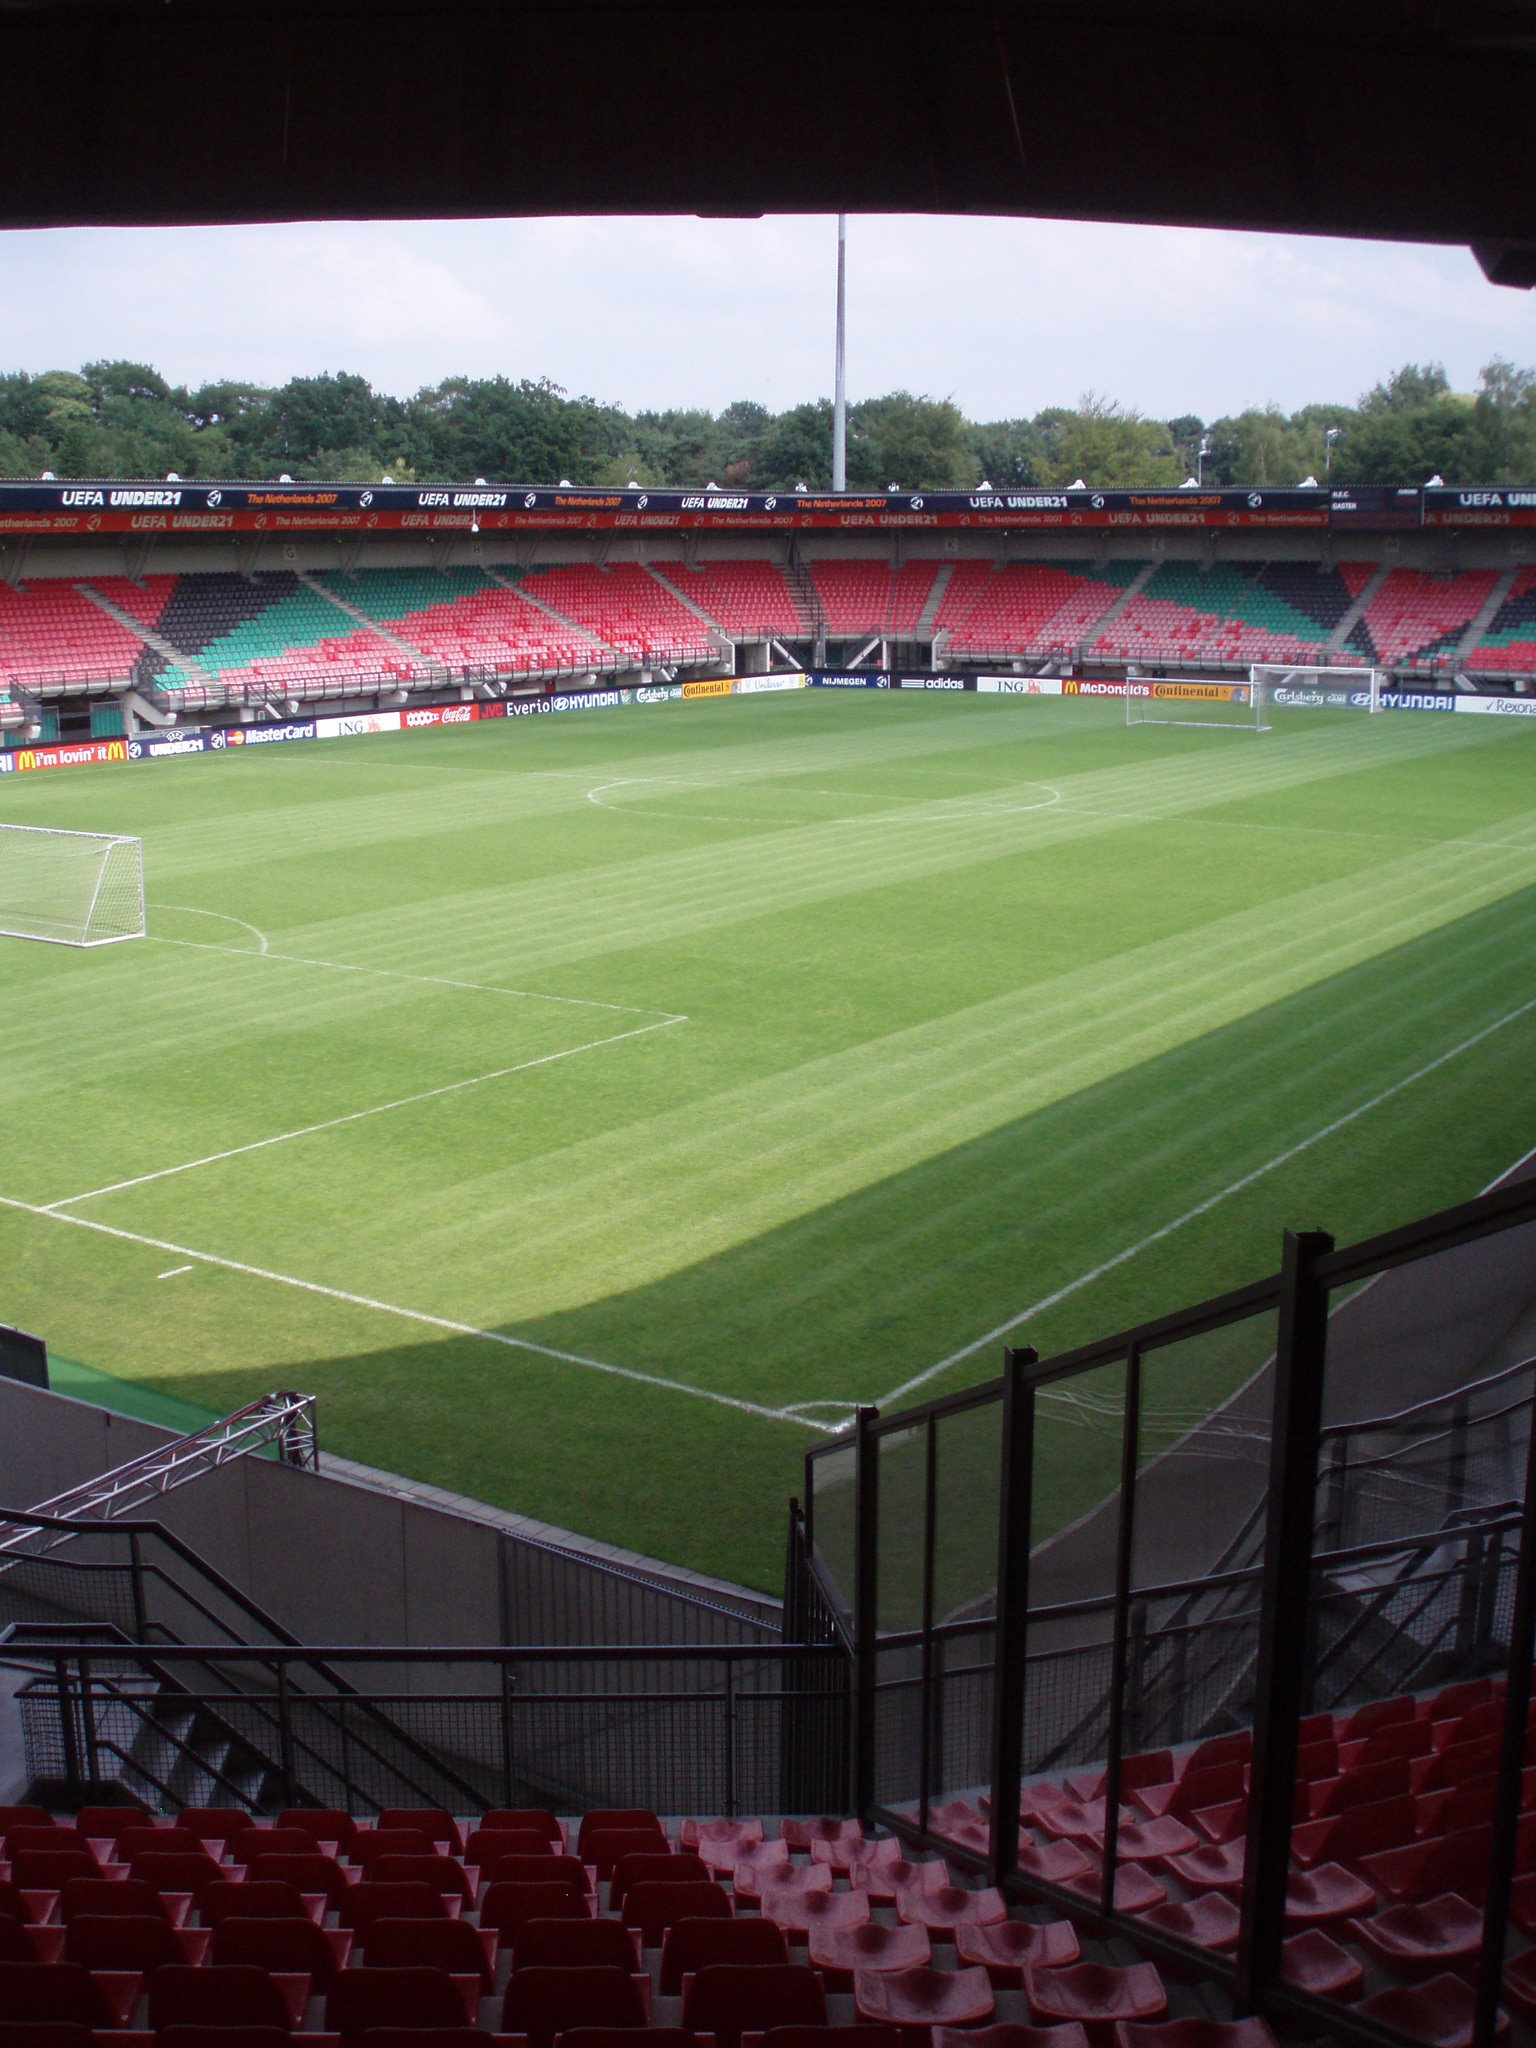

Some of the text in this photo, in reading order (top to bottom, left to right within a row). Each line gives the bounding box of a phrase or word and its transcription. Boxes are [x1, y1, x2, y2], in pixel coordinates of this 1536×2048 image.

[62, 491, 182, 505] UEFA UNDER21
[248, 494, 338, 504] The Netherlands 2007
[418, 493, 507, 506] UEFA UNDER21
[555, 496, 622, 506] The Netherlands 2007
[681, 498, 748, 508] UEFA UNDER21
[797, 499, 887, 508] The Netherlands 2007
[969, 496, 1068, 508] UEFA UNDER21
[1129, 496, 1222, 505] The Netherlands 2007
[1460, 493, 1503, 505] UEFA
[53, 517, 78, 527] 2007
[132, 515, 234, 527] UEFA UNDER21
[292, 516, 339, 524] Netherlands
[341, 516, 360, 524] 2007
[401, 515, 429, 525] UEFA
[615, 515, 680, 524] UEFA UNDER21
[841, 515, 937, 524] UEFA UNDER21
[1109, 514, 1205, 523] UEFA UNDER21
[1442, 514, 1510, 523] UNDER21
[286, 548, 294, 559] G
[822, 677, 866, 685] NIJMEGEN
[926, 678, 964, 689] adidas
[998, 681, 1024, 692] ING
[637, 687, 669, 702] Carlsberg
[683, 682, 724, 698] Continental
[1080, 683, 1150, 696] McDonald's
[1155, 684, 1219, 698] Continental
[570, 692, 619, 710] HYUNDAI
[1274, 688, 1324, 705] Carlsberg
[1376, 694, 1454, 710] HYUNDAI
[481, 700, 550, 718] JVC Everio
[339, 721, 363, 735] ING
[246, 727, 313, 743] MasterCard
[150, 739, 204, 756] UNDER21
[36, 750, 59, 767] i'm
[97, 745, 107, 760] it
